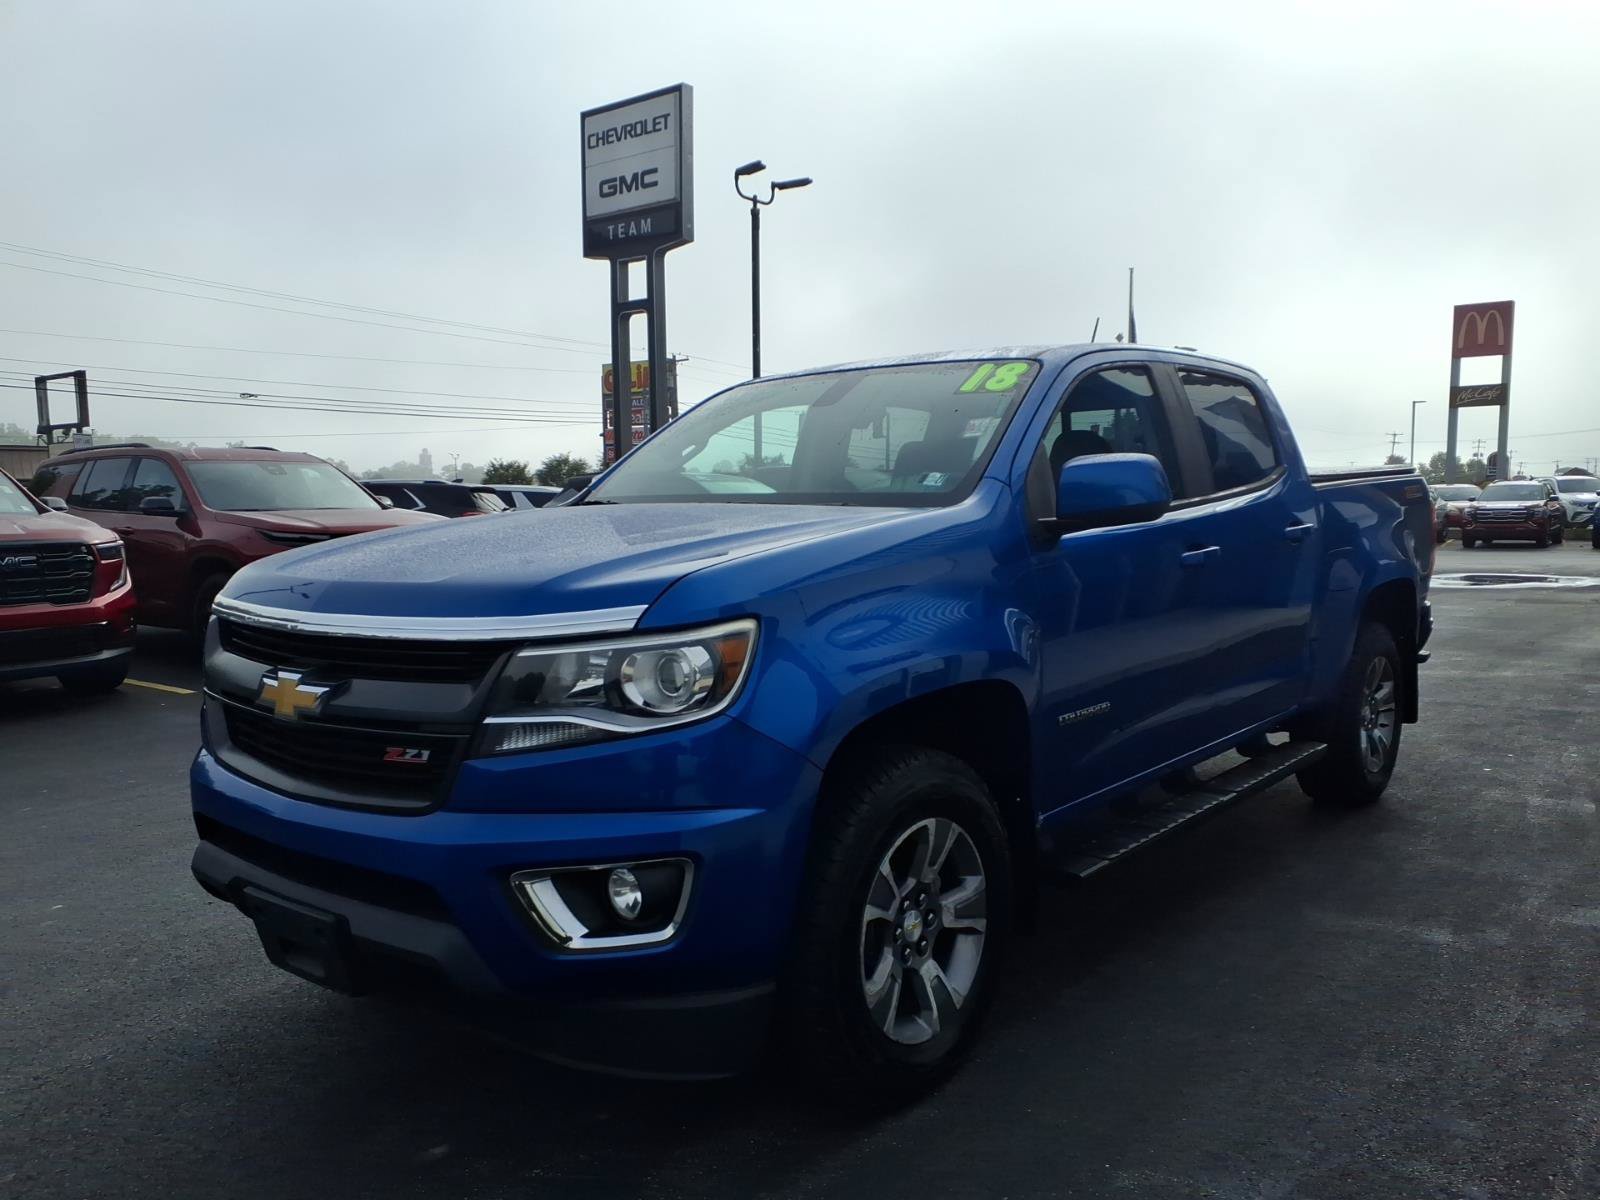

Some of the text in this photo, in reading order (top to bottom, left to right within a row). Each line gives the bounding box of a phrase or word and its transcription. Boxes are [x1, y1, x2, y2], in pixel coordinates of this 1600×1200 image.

[587, 113, 670, 149] CHEVROLET
[599, 167, 658, 198] GMC
[608, 218, 652, 240] TEAM
[959, 363, 1028, 392] 18
[383, 747, 430, 763] Z71
